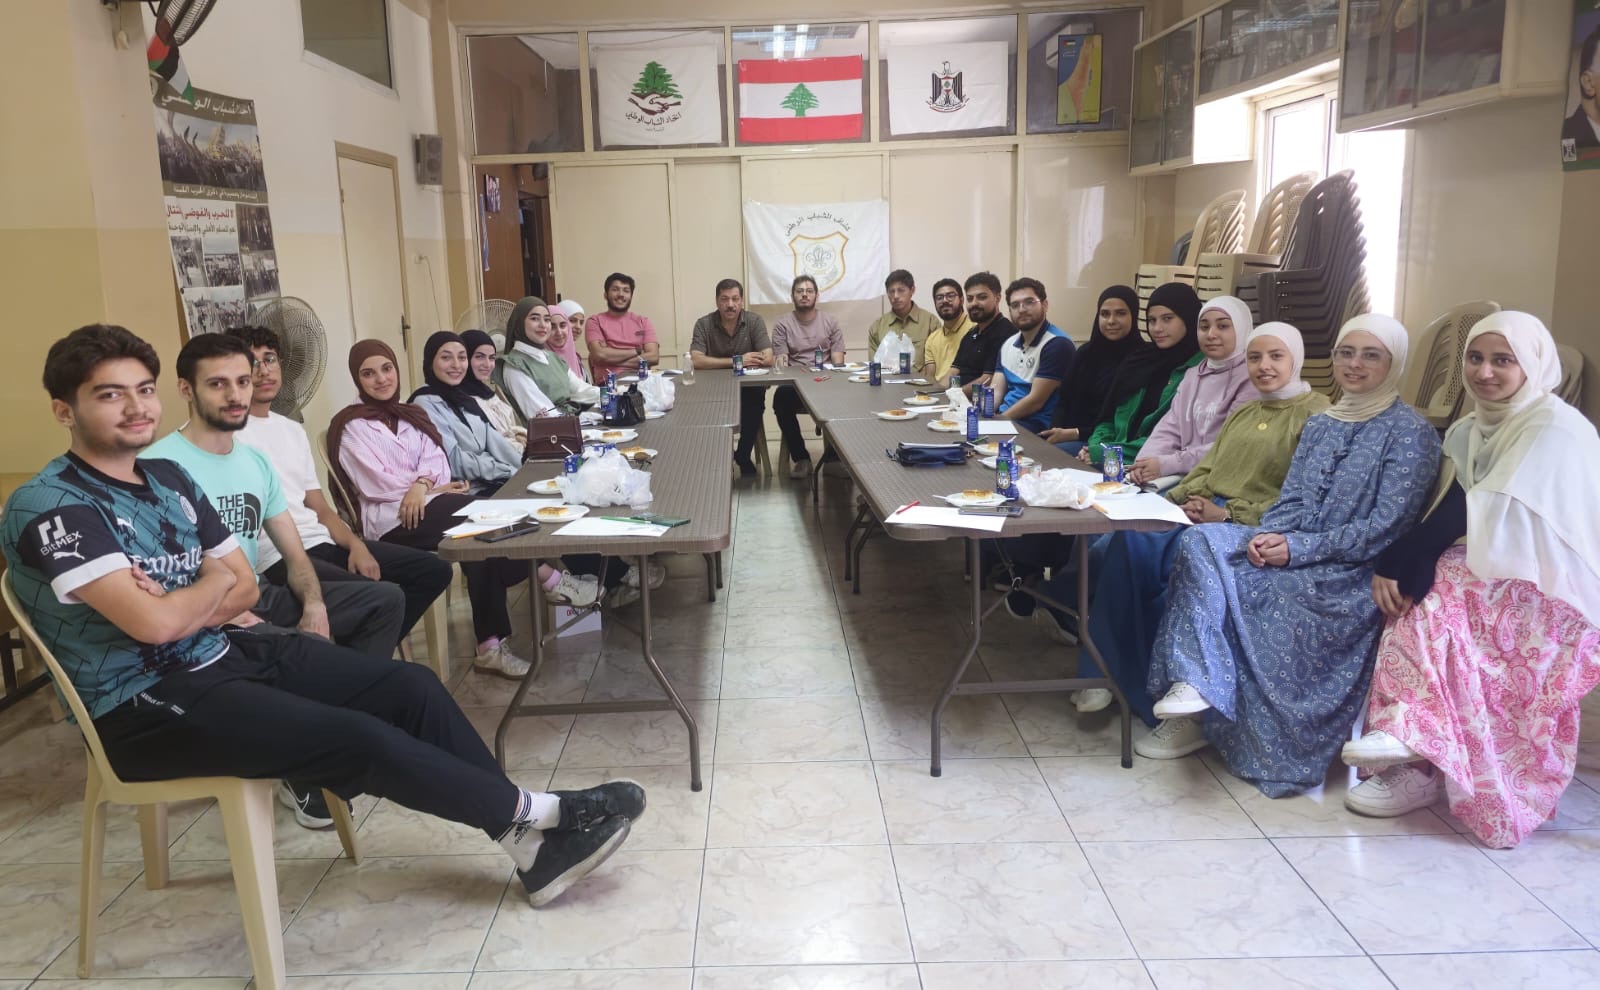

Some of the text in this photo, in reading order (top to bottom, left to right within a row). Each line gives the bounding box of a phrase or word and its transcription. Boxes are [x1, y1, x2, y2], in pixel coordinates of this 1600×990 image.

[161, 95, 211, 110] الوني
[216, 494, 243, 509] THE
[219, 508, 244, 522] RTH
[226, 520, 243, 534] CE
[40, 530, 83, 556] BitMEX
[128, 545, 203, 575] Emirate
